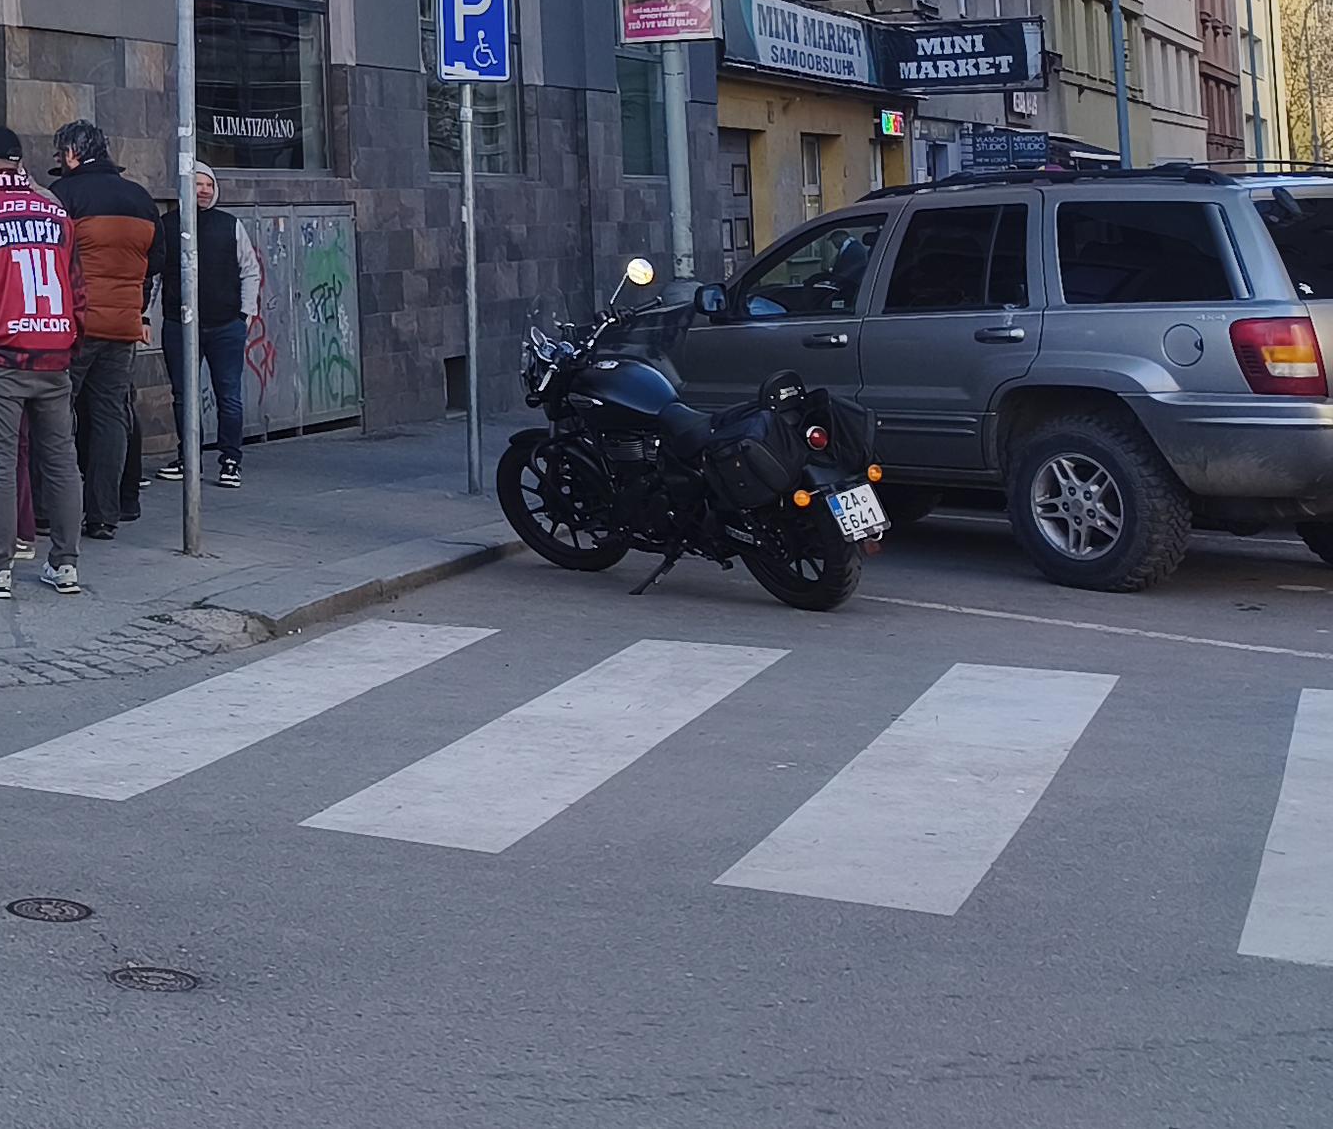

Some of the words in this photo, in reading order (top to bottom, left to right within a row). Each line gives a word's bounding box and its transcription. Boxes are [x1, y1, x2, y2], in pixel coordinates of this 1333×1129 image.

[757, 2, 800, 44] MINI
[803, 16, 862, 58] MARKET
[915, 34, 984, 56] MINI
[770, 44, 857, 77] SAMOOBSLUHA
[899, 56, 1013, 80] MARKET
[213, 113, 294, 139] KLIMATIZOVÁNO
[975, 143, 1008, 152] STUDIO
[1013, 142, 1046, 151] STUDIO
[12, 248, 64, 315] 14
[7, 318, 70, 334] SENCOR
[841, 492, 861, 511] 2A
[839, 507, 878, 533] E641
